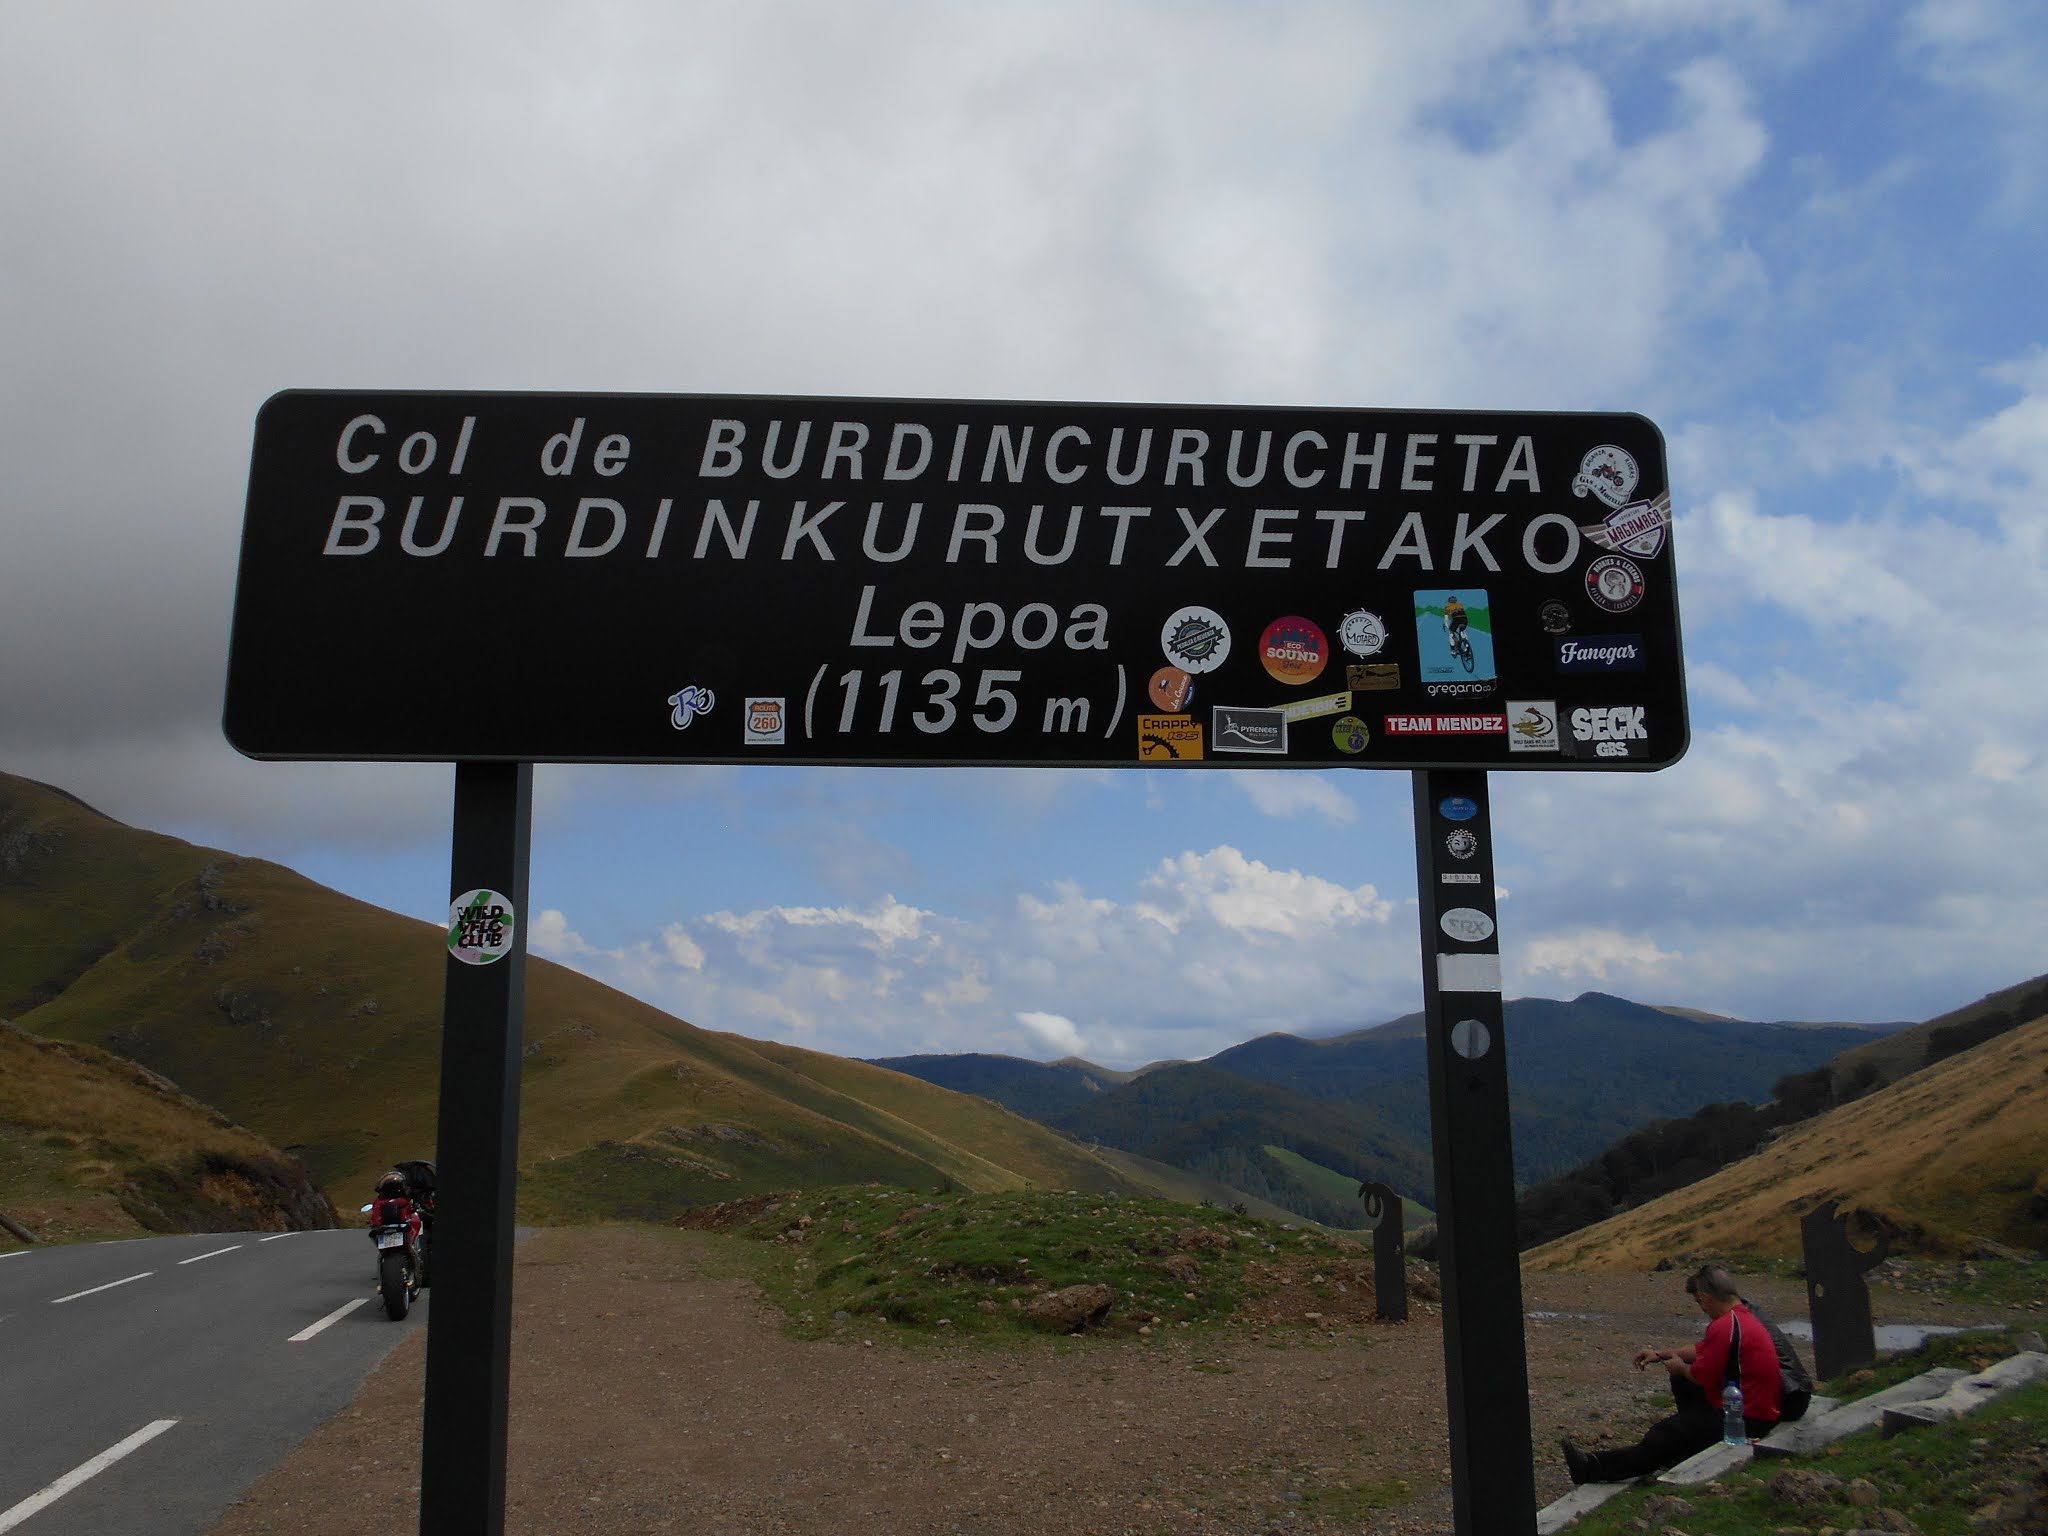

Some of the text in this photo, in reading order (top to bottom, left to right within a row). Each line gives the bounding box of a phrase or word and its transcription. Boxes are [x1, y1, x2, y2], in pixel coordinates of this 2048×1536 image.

[337, 414, 1541, 492] Col de BURDINCURUCHETA
[323, 496, 1579, 573] BURDINKURUTXETAKO
[1607, 509, 1663, 544] MAGAMAGA
[850, 586, 1108, 663] Lepoa
[1266, 647, 1319, 663] SOUND
[1561, 642, 1638, 665] Fanegas
[805, 664, 1126, 738] (1135 m)
[753, 717, 777, 729] 260
[1143, 718, 1198, 730] CRAPPY
[1388, 717, 1503, 731] TEAM MENDEZ
[1571, 707, 1647, 741] SECK
[1167, 731, 1199, 740] 105
[1595, 742, 1628, 757] GBS
[457, 905, 504, 920] WILD
[457, 933, 503, 948] CLUB
